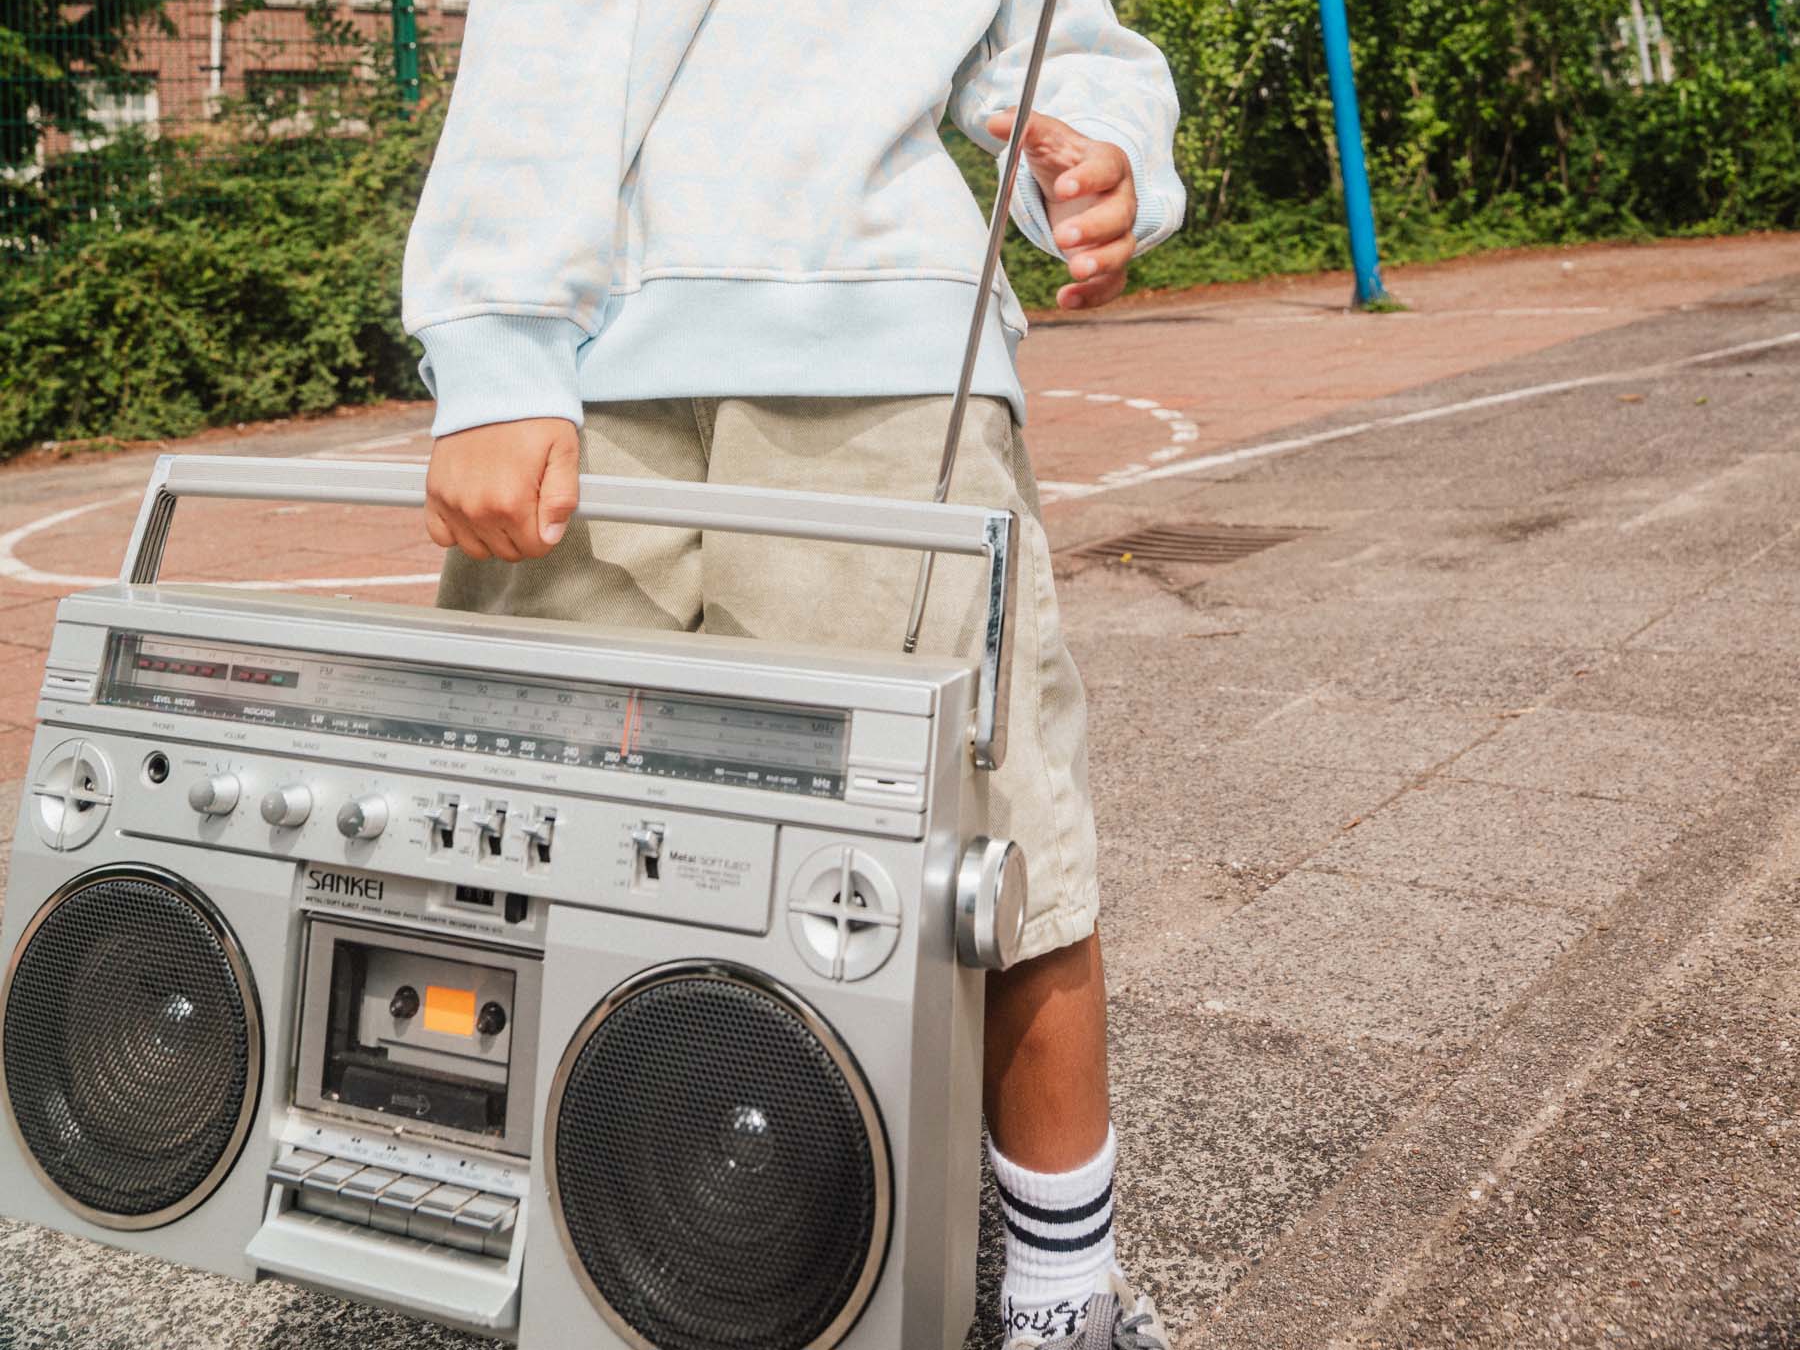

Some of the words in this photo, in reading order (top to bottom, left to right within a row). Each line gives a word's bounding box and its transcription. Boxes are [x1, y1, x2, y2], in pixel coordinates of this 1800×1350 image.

[153, 694, 171, 705] LEVEL
[174, 698, 196, 708] METER
[243, 706, 276, 718] INDICATOR
[520, 740, 537, 752] 200
[669, 850, 697, 864] Metal
[306, 870, 384, 901] SANKEI
